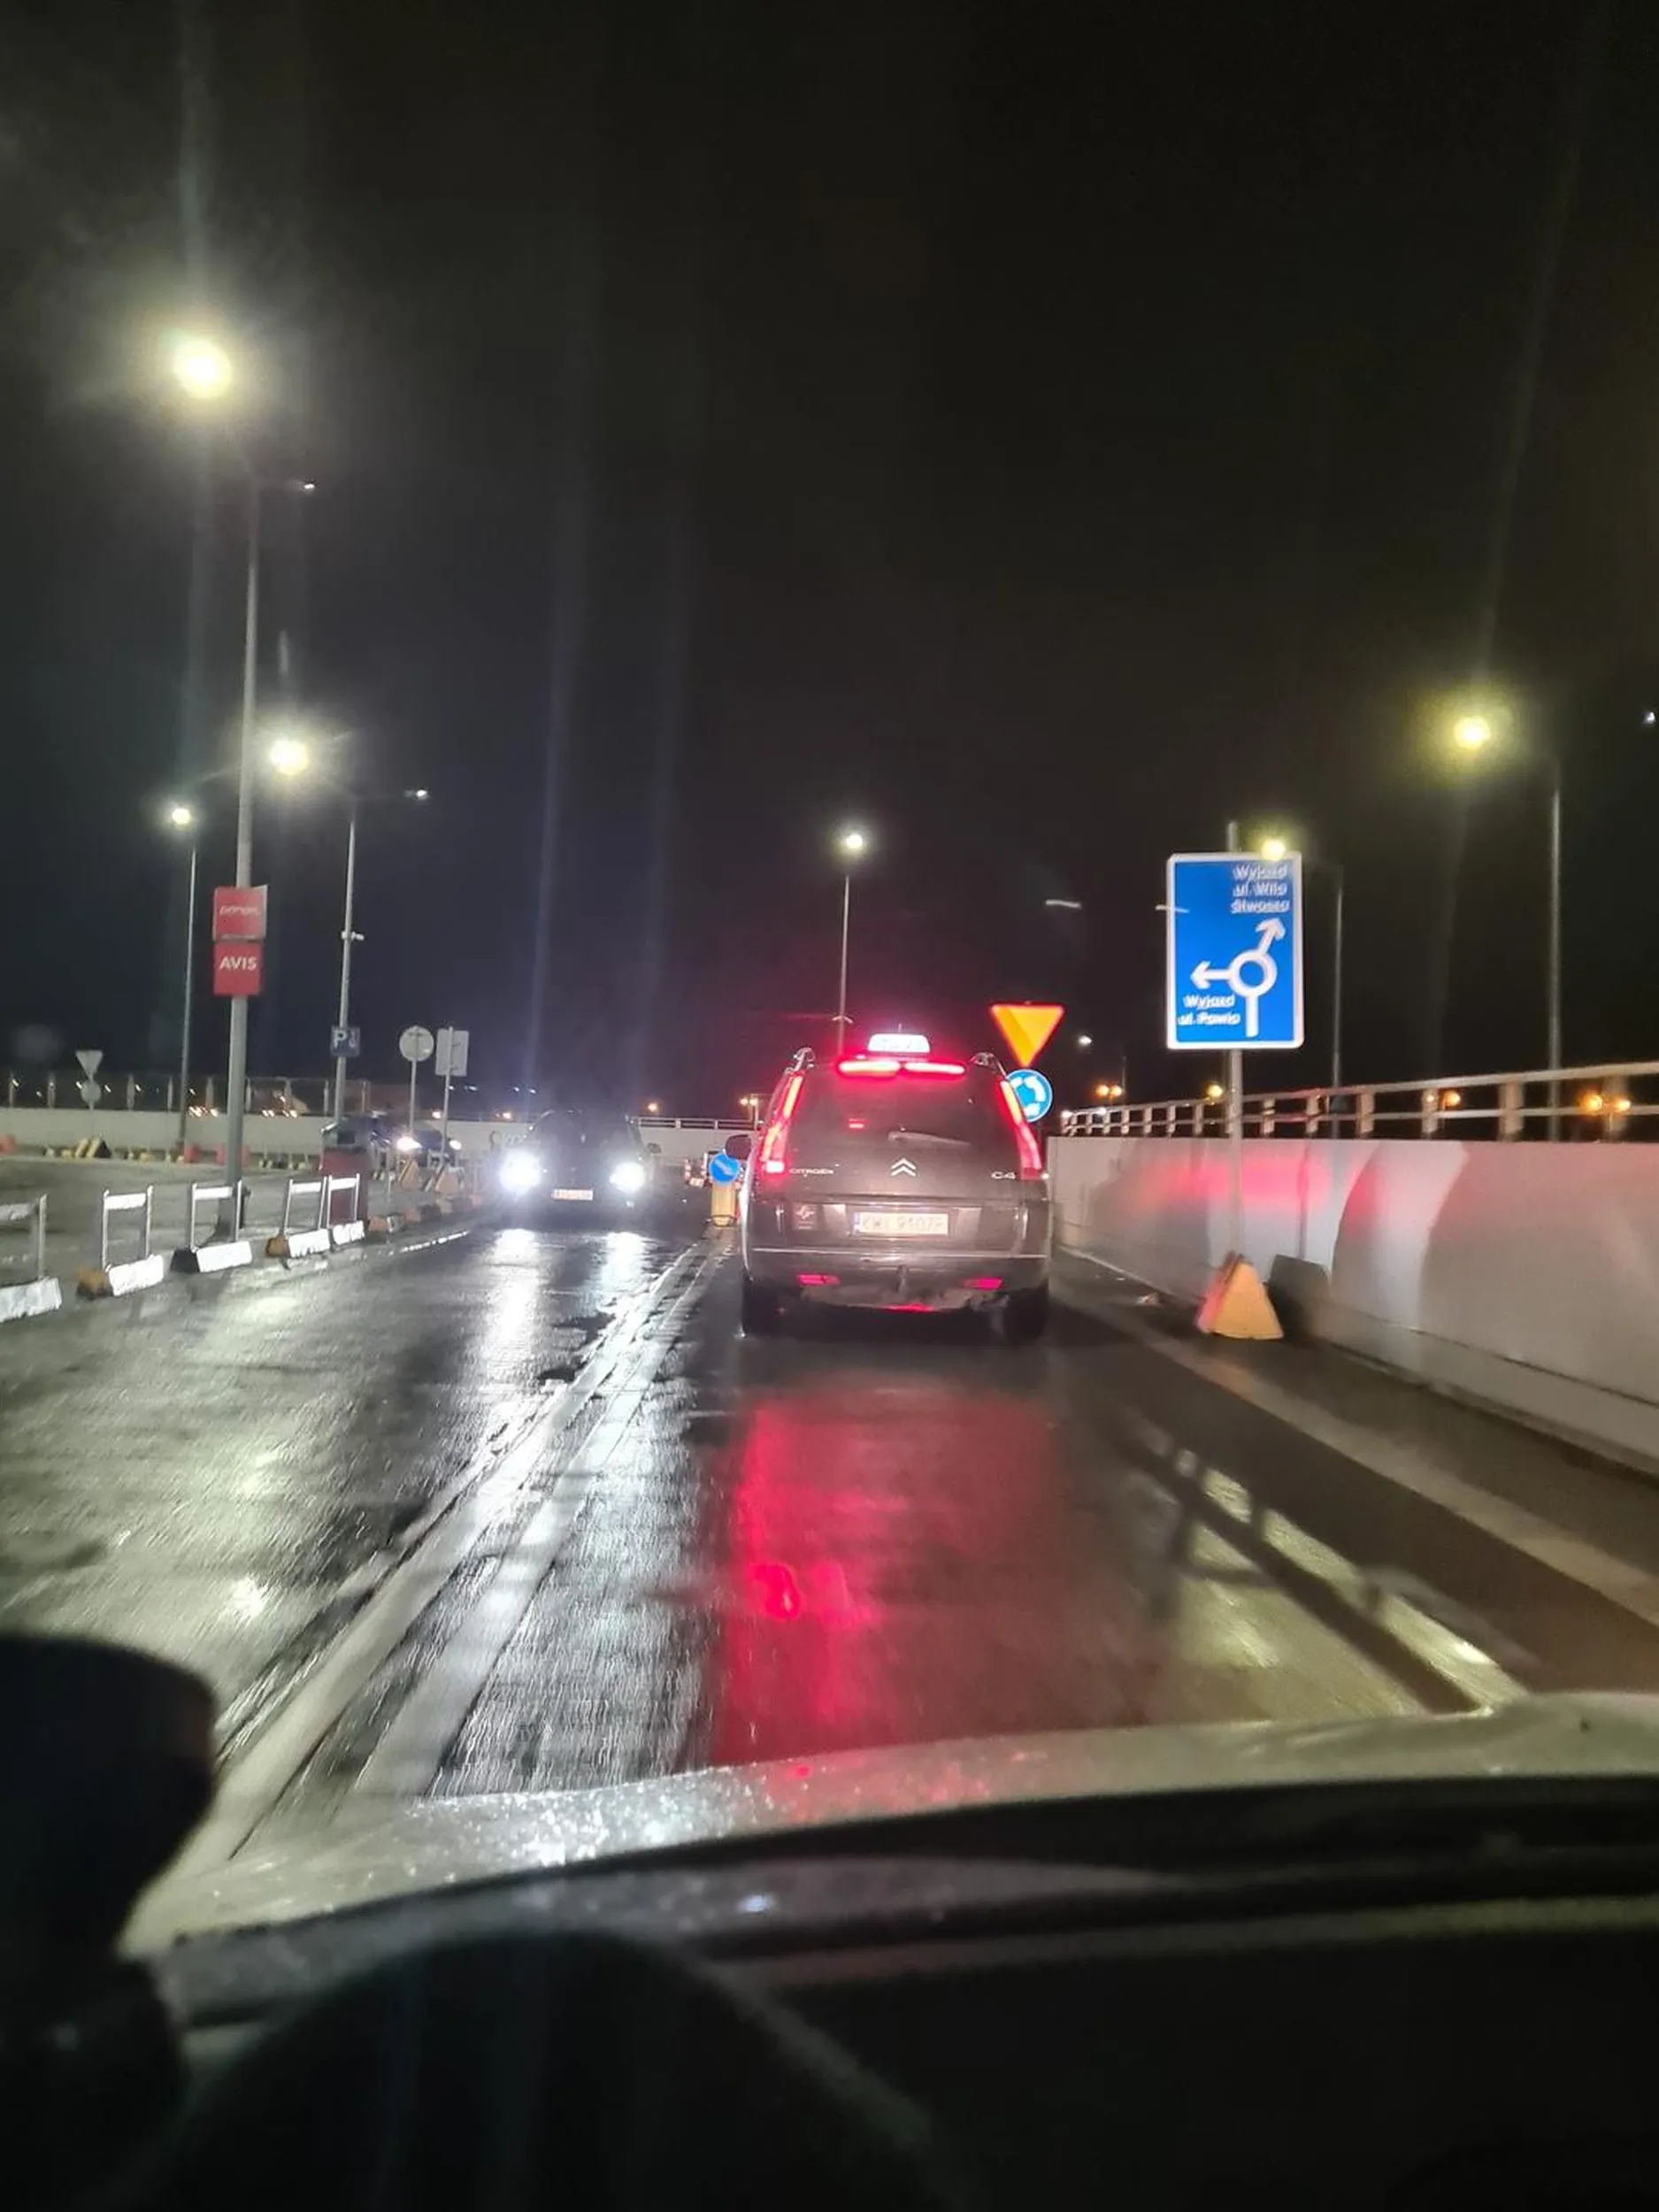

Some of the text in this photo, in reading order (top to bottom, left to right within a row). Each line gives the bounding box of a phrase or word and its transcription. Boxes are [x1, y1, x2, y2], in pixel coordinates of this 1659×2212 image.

[219, 956, 258, 971] AVIS
[334, 1029, 348, 1049] P
[990, 1171, 1017, 1180] C4
